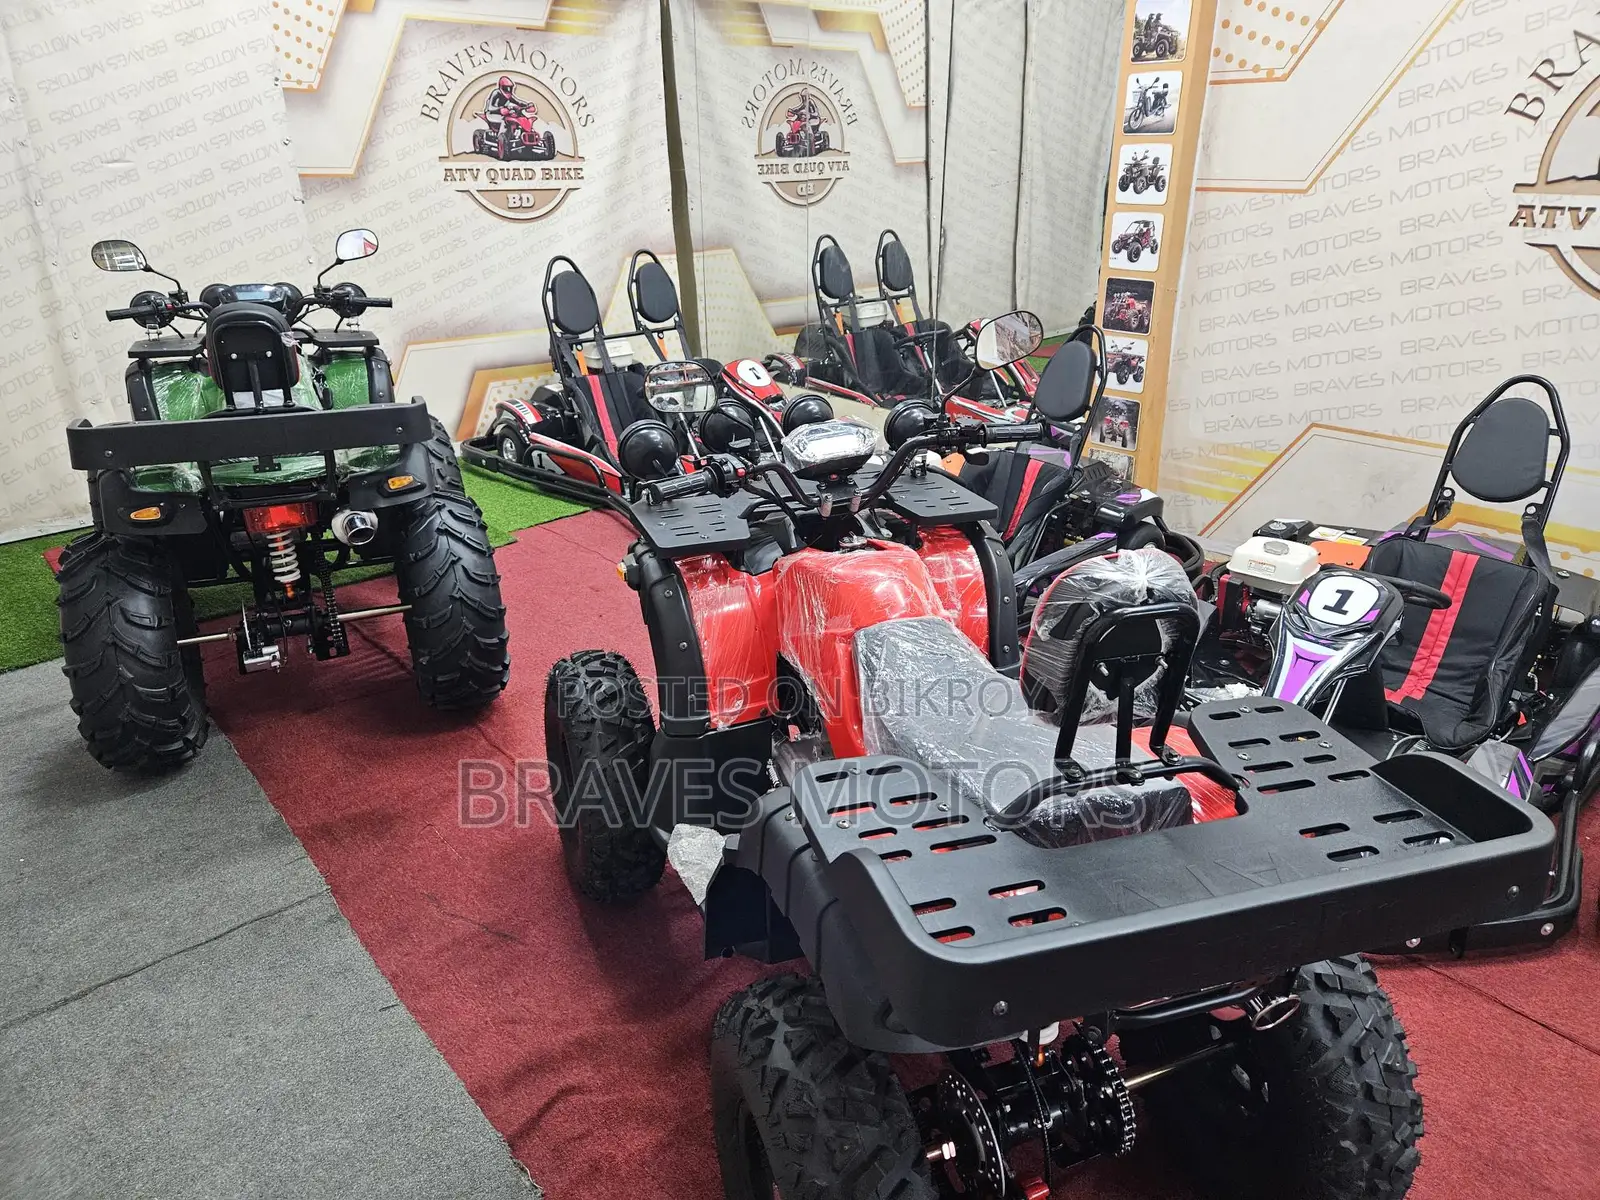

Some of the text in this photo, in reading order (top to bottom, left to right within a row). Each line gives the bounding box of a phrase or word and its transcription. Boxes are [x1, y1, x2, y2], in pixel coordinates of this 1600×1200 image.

[420, 40, 595, 128] BRAVES MOTORS
[1398, 62, 1508, 109] BRAVES
[1389, 95, 1504, 142] MOTORS
[443, 167, 585, 185] ATV QUAD BIKE
[1399, 131, 1508, 173] BRAVES
[507, 193, 535, 208] BD
[1193, 164, 1504, 228] BRAVES MOTORS
[1508, 204, 1597, 230] ATV
[1188, 193, 1383, 254] MOTORS BRAVES
[1197, 197, 1507, 280] BRAVES MOTORS BRAVES
[1190, 230, 1504, 307] MOTORS BRAVES MOTORS
[1199, 263, 1508, 333] BRAVES MOTORS BRAVES
[1193, 333, 1277, 359] MOTORS
[1292, 315, 1384, 343] BRAVES
[1390, 294, 1503, 327] MOTORS
[1201, 360, 1281, 384] BRAVES
[1286, 345, 1383, 372] MOTORS
[1400, 327, 1507, 356] BRAVES
[1196, 387, 1279, 409] MOTORS
[1294, 372, 1385, 396] BRAVES
[1391, 357, 1503, 385] MOTORS
[1204, 403, 1383, 434] BRAVES MOTORS
[1322, 589, 1355, 615] 1
